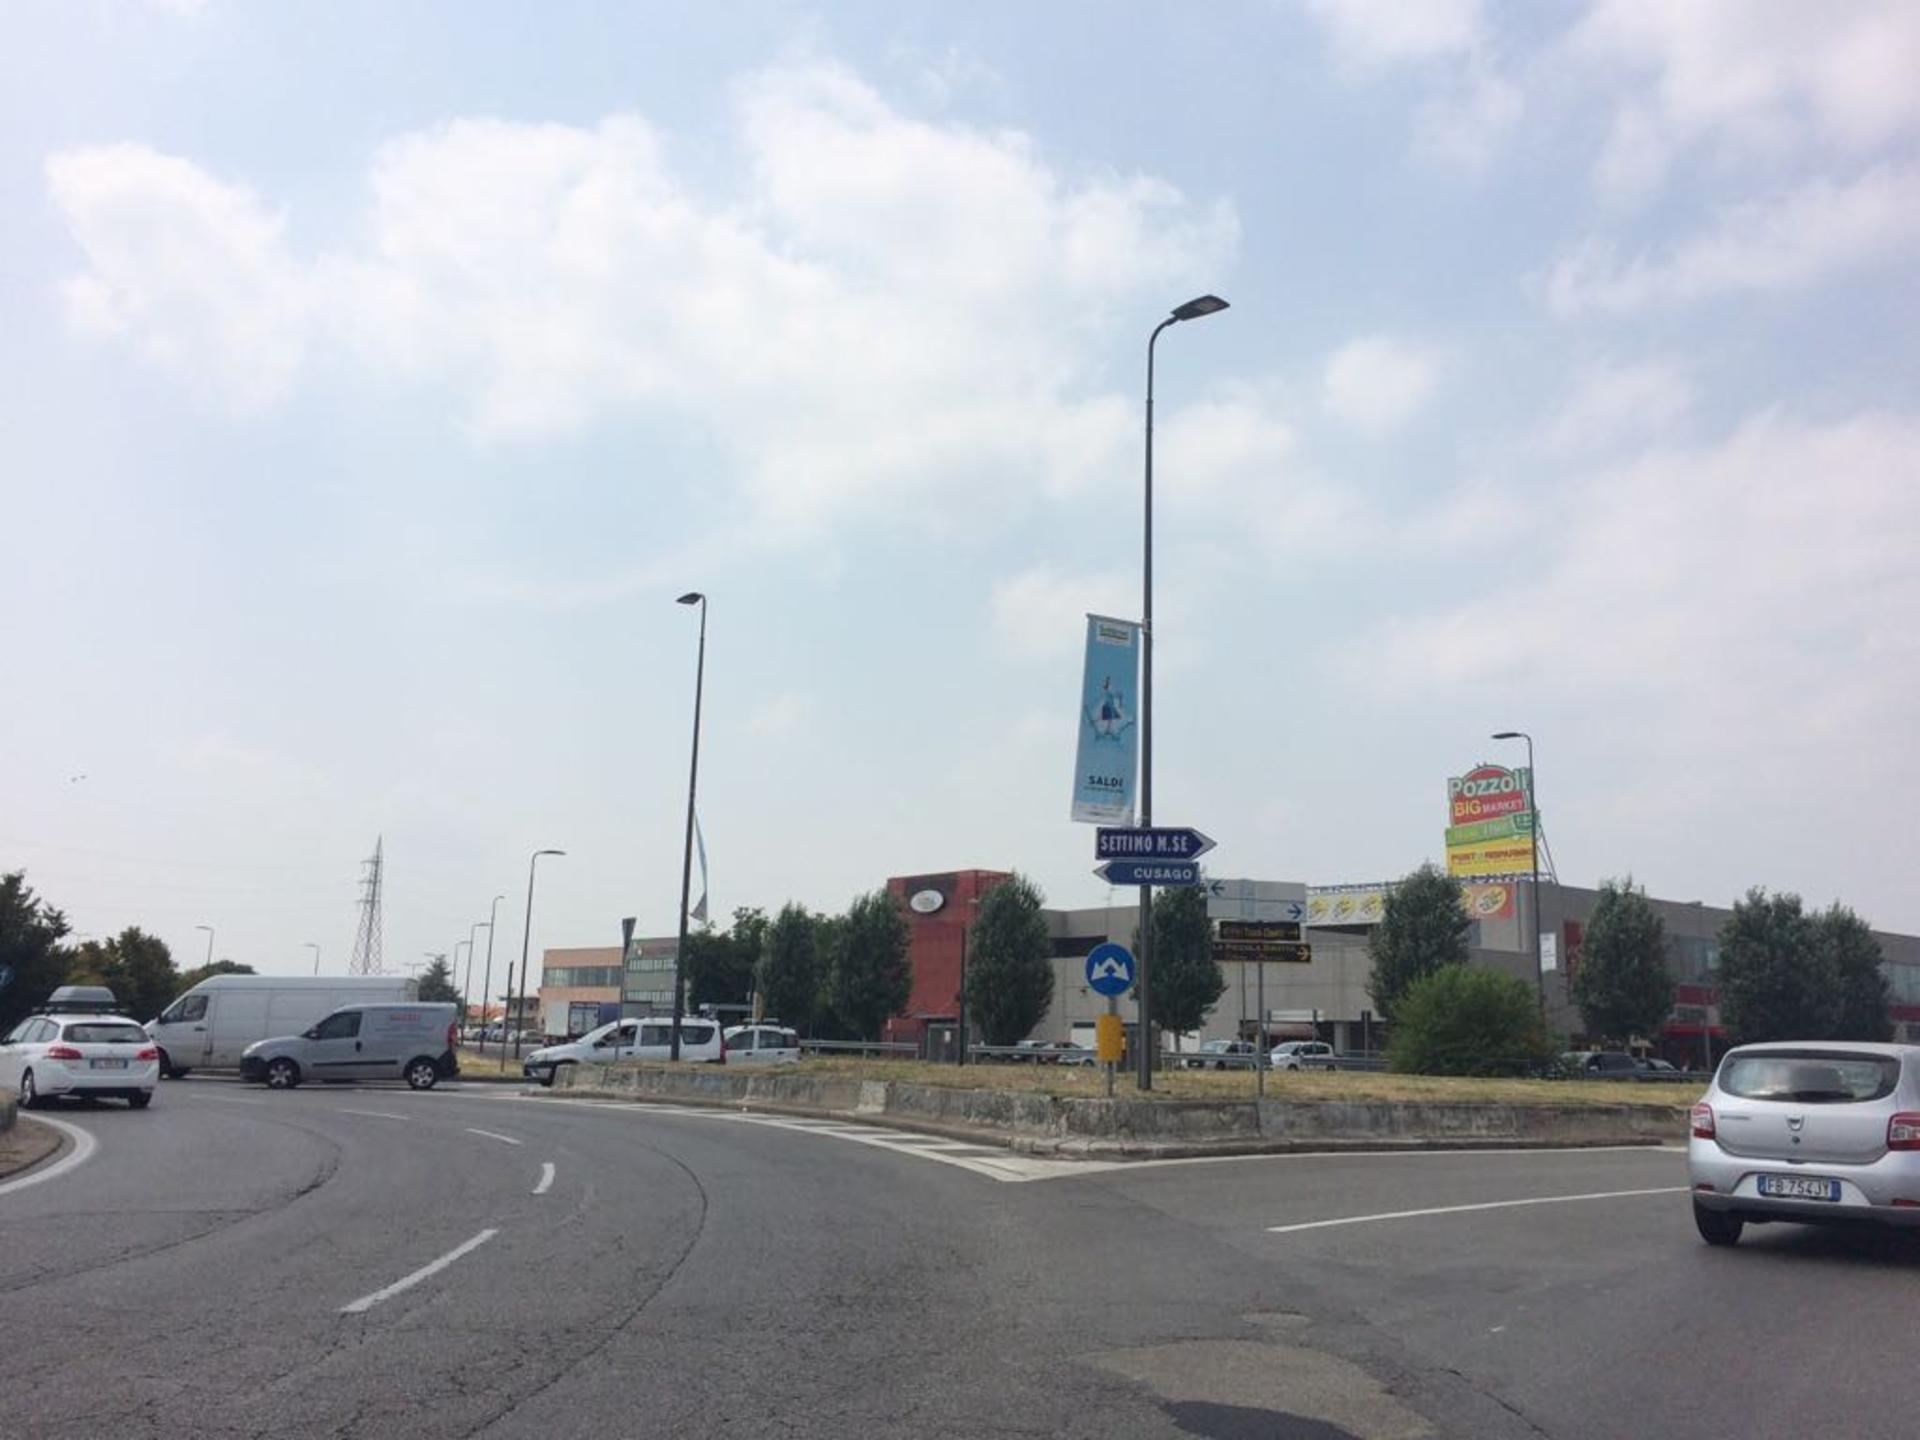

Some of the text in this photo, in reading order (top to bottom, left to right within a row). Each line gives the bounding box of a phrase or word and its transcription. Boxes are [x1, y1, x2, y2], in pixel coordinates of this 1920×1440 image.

[1088, 775, 1124, 788] SALDI
[1449, 767, 1527, 799] Pozzoli
[1454, 799, 1524, 817] BIG MARKET
[1100, 834, 1189, 853] SETTIMO M.SE
[1133, 867, 1193, 880] CUSAGO
